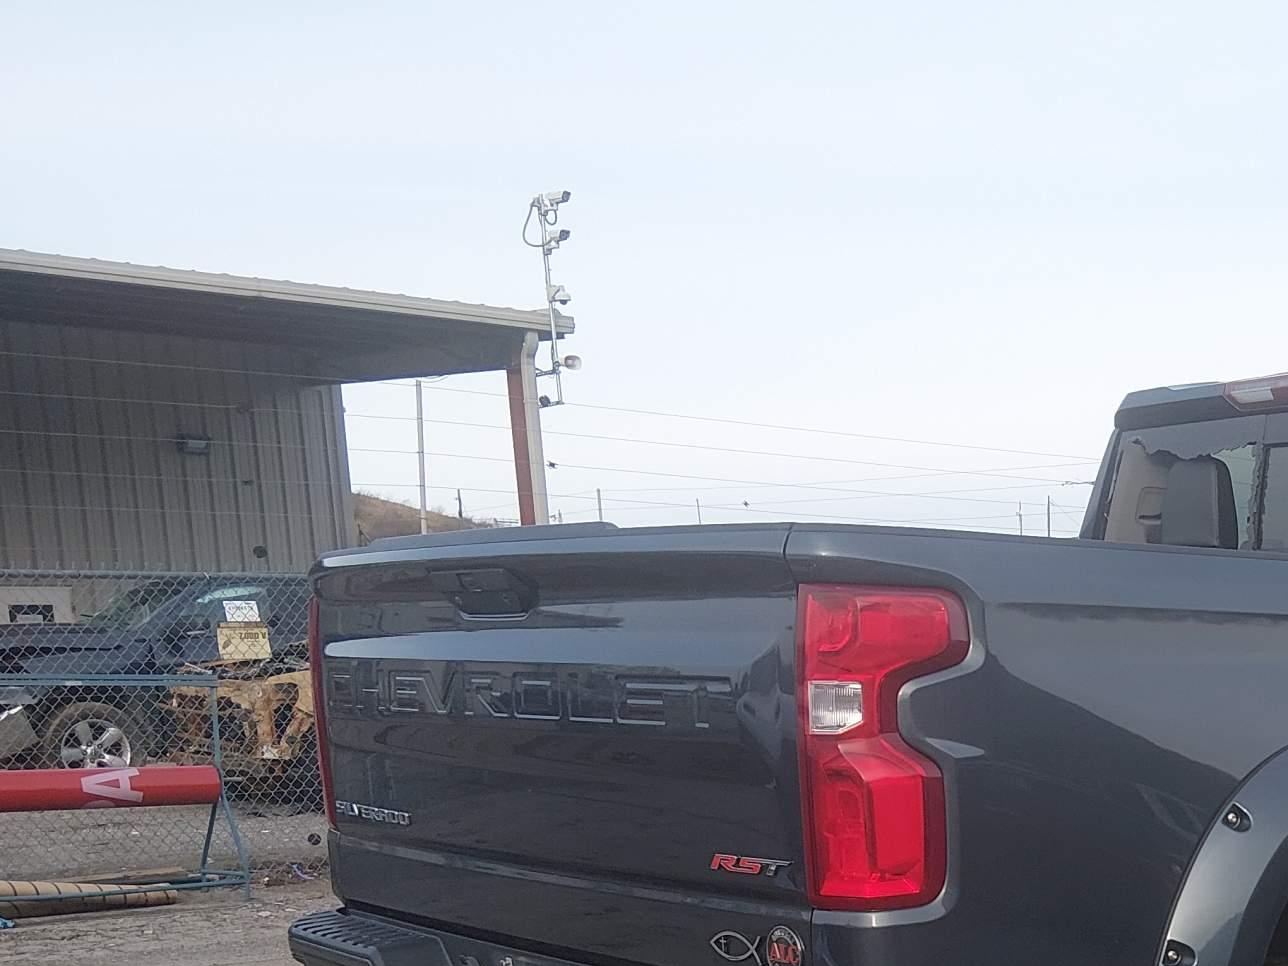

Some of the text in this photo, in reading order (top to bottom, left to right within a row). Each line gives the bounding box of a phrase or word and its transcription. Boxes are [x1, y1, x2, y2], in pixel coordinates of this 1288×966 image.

[328, 665, 732, 729] CHEVROLET
[81, 768, 143, 803] A
[335, 800, 411, 826] SILVERADO
[710, 853, 795, 877] RST
[769, 942, 800, 966] ALC
